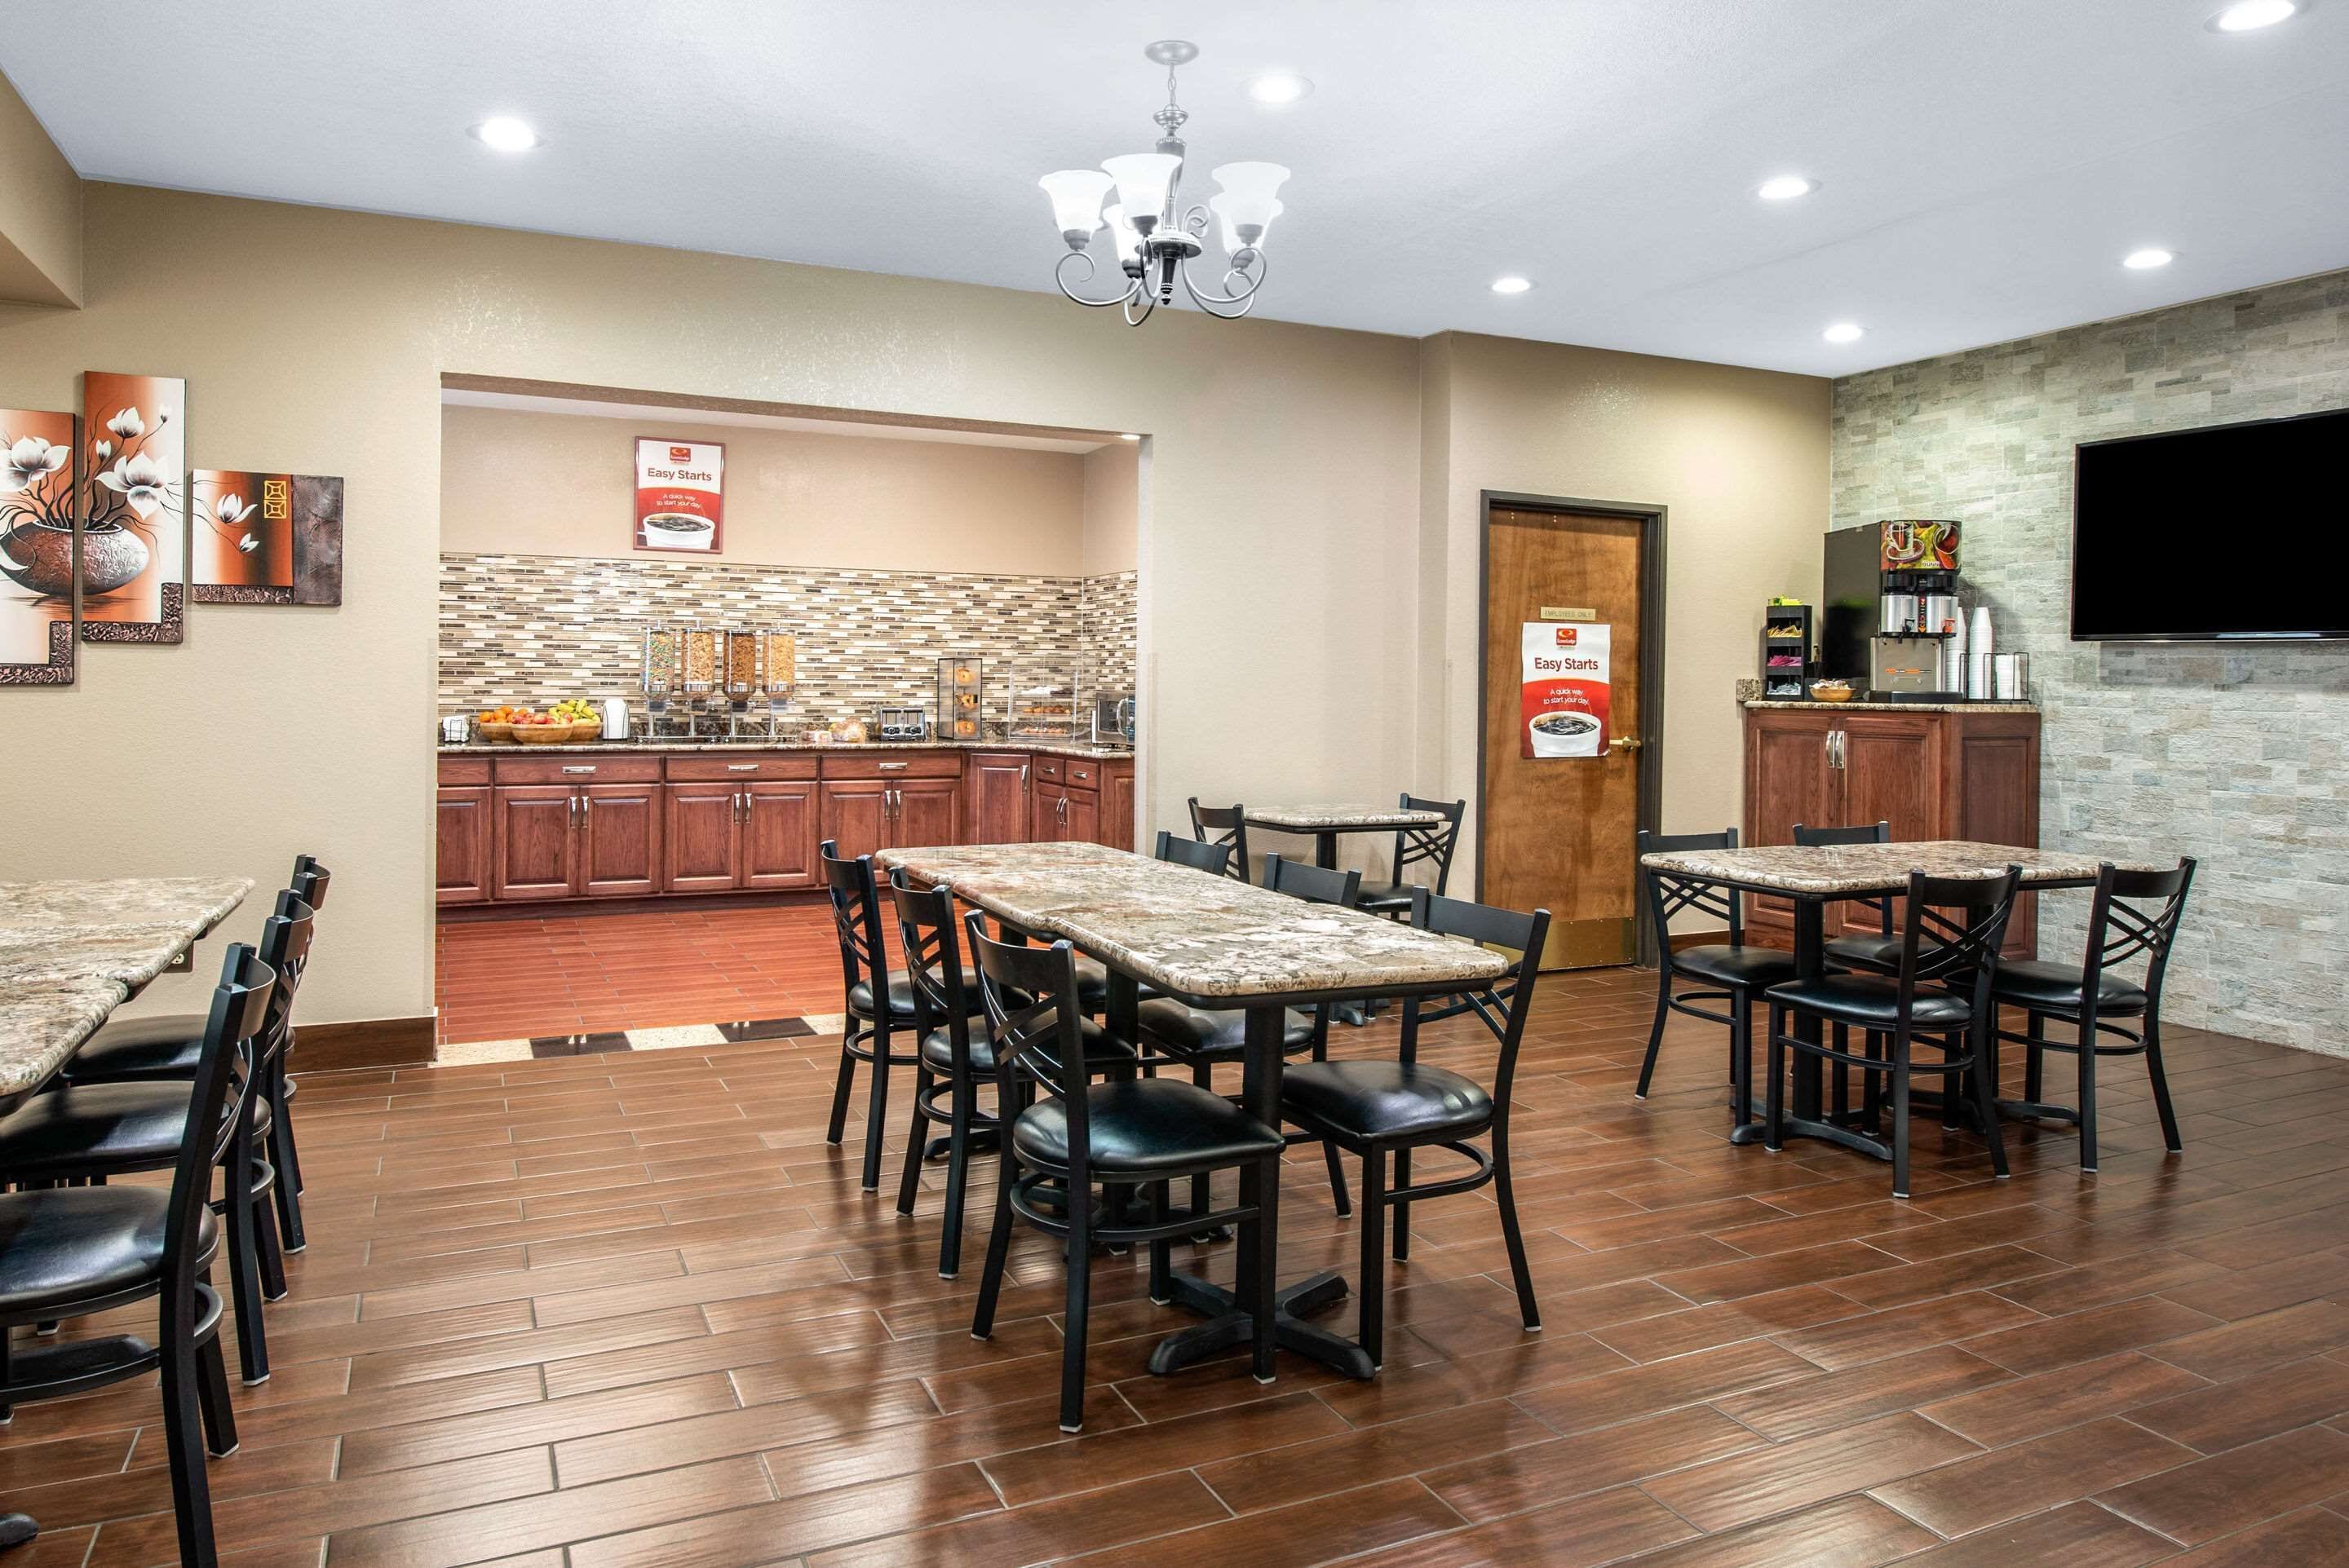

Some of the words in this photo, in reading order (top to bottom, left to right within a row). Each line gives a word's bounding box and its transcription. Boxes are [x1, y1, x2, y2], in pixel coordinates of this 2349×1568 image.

[648, 467, 675, 479] Easy
[678, 470, 712, 481] Starts
[1534, 657, 1563, 672] Easy
[1564, 658, 1599, 670] Starts
